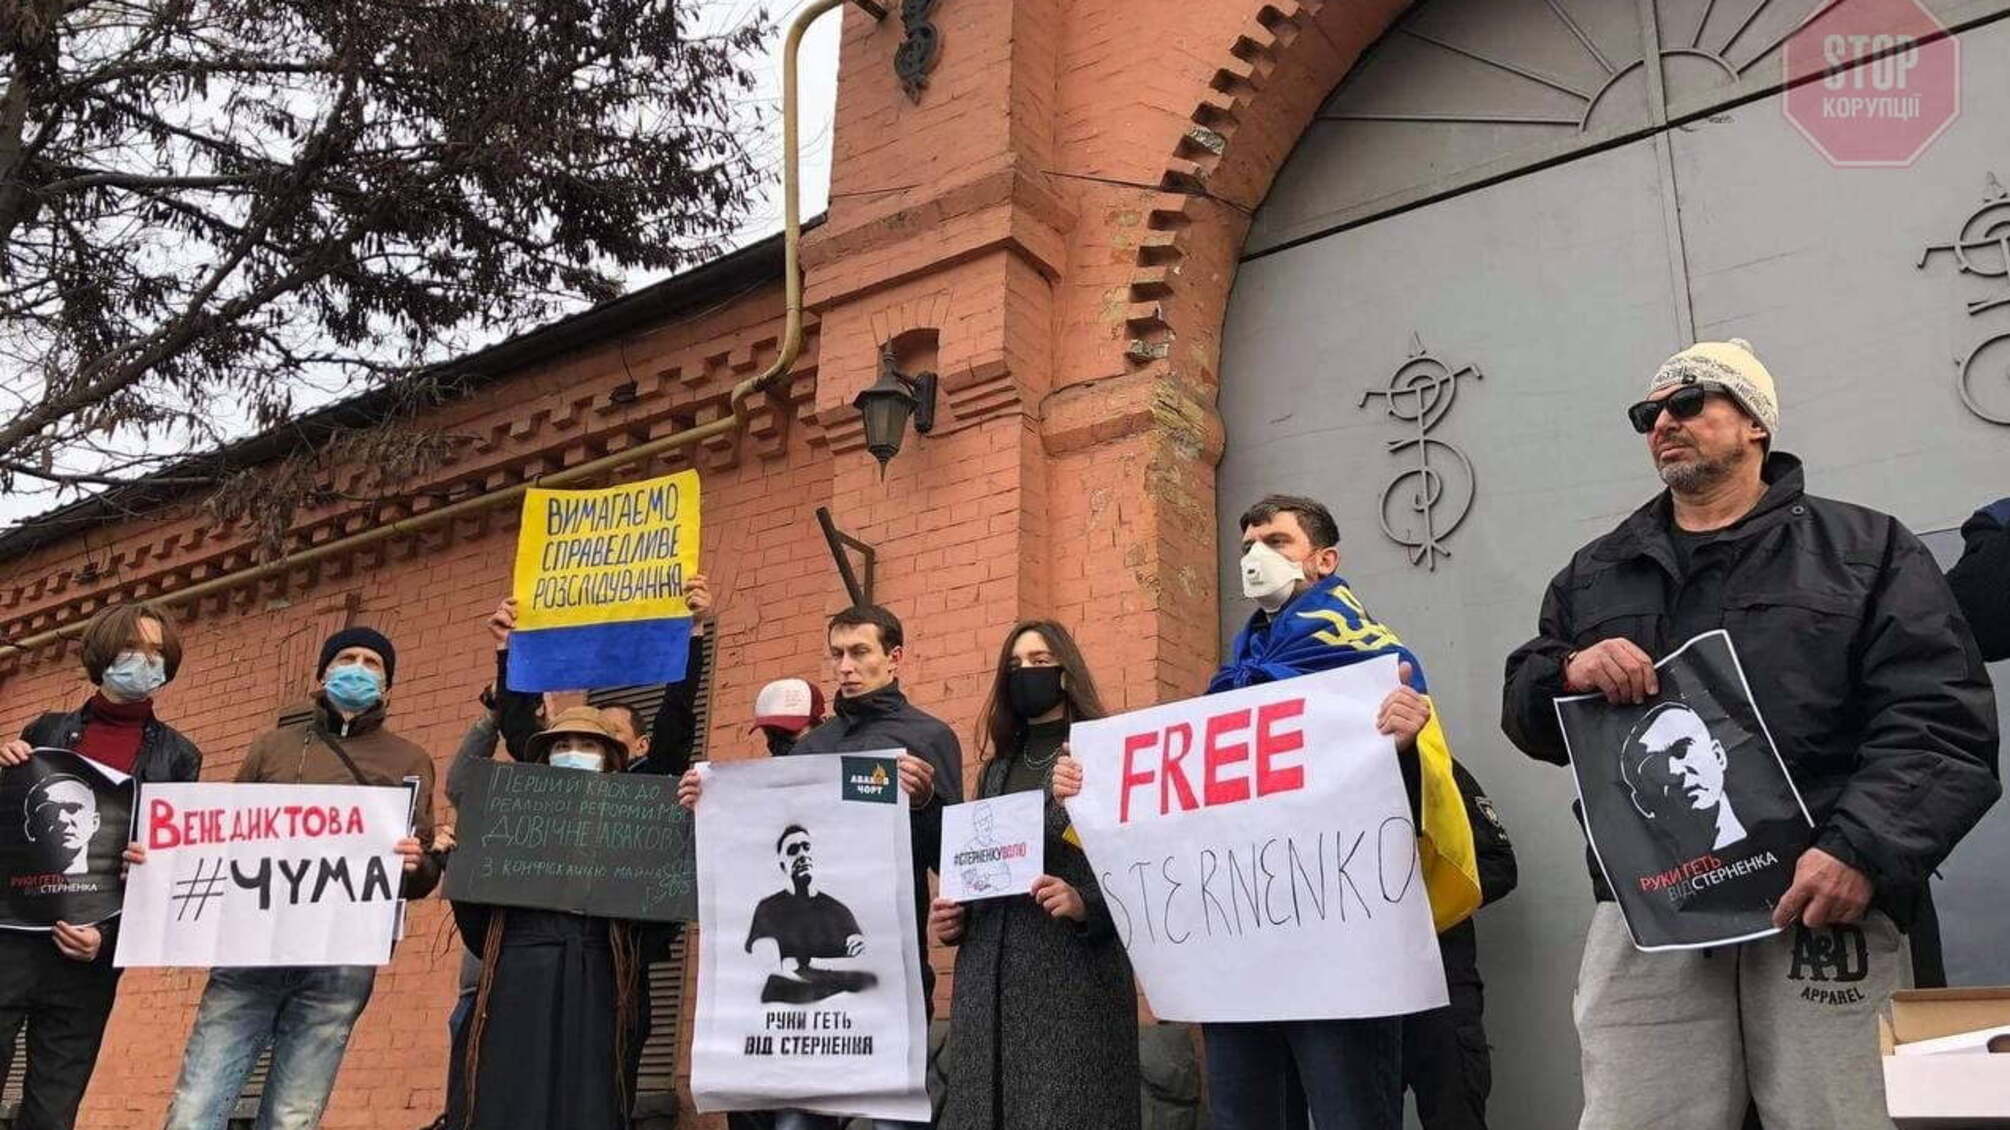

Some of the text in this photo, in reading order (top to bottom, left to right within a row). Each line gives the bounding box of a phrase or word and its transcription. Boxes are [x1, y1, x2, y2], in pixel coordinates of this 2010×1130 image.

[547, 482, 679, 536] ВИМАГАЄМО
[542, 525, 682, 572] СПРАВЕДЛИВЕ
[533, 563, 683, 610] РОЗСЛІДУВАННЯ
[491, 766, 661, 801] ПЕРШИЙ КРОК ДО
[1119, 697, 1306, 823] FREE
[147, 798, 365, 850] ВЕНЕДИКТОВА
[481, 814, 592, 849] ДОВІЧНЕ
[172, 856, 393, 921] #ЧУМА
[1102, 816, 1417, 949] STERNENKO
[1640, 853, 1722, 891] РУКИ ГЕТЬ
[1801, 986, 1865, 1005] APPAREL
[766, 1011, 852, 1030] РУКИ ГЕТЬ
[744, 1035, 873, 1055] ВІД СТЕРНЕНКА
